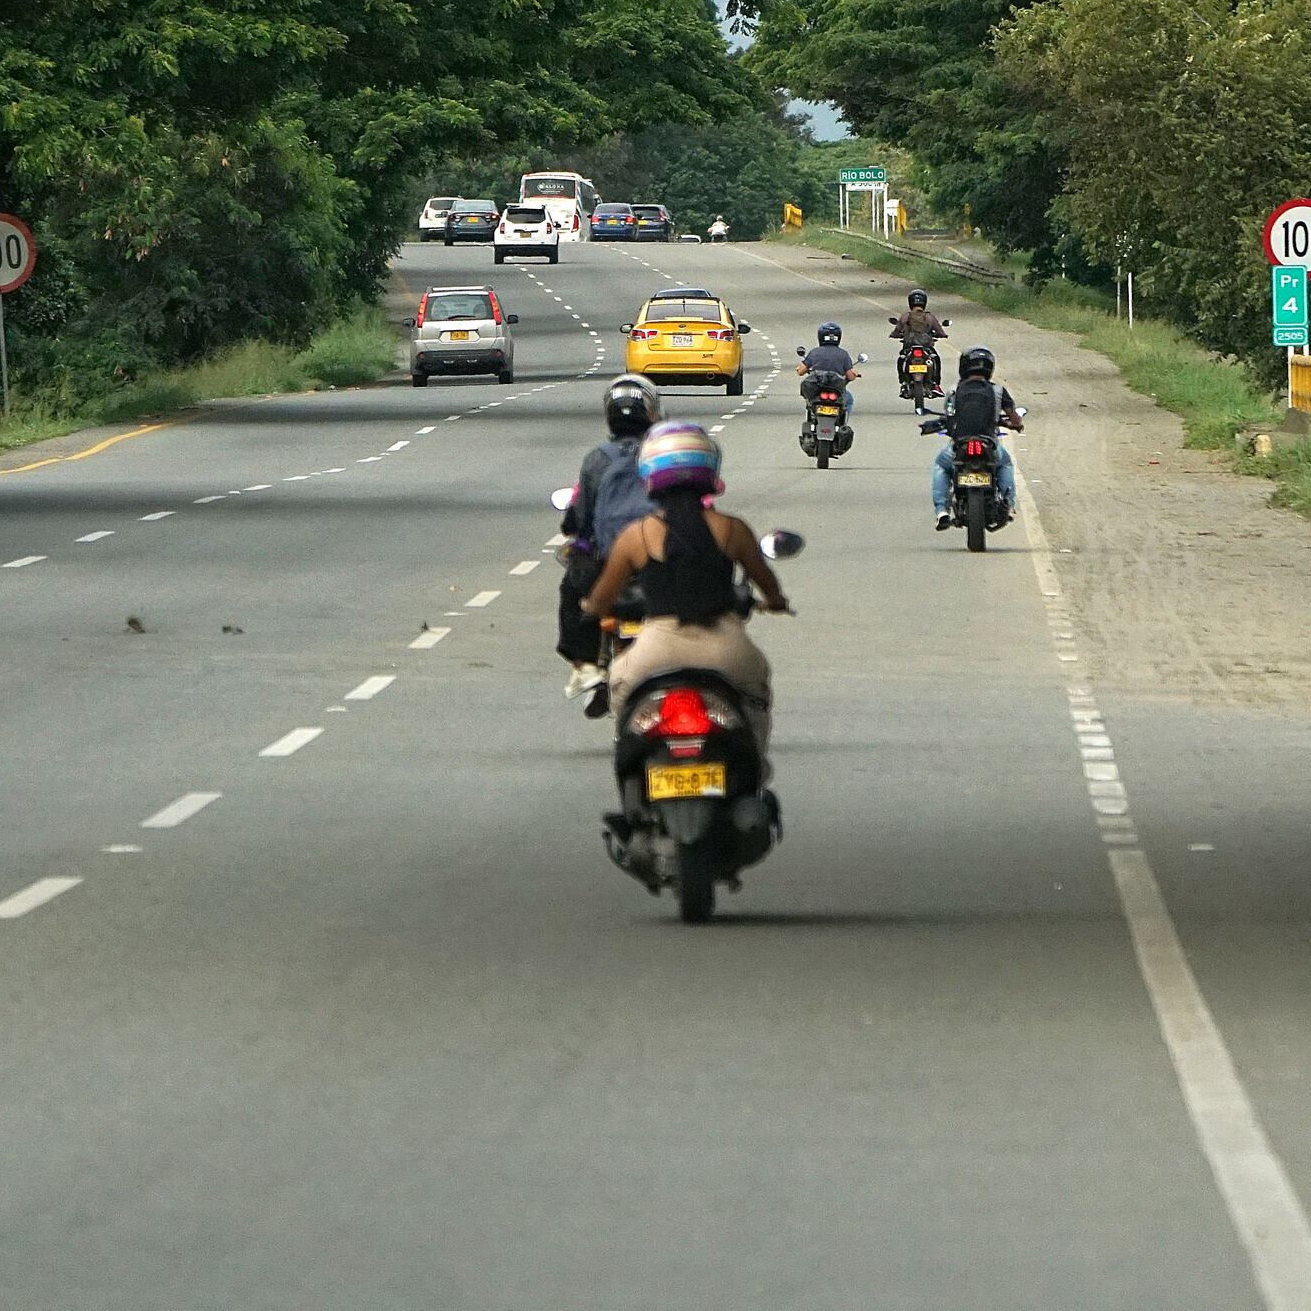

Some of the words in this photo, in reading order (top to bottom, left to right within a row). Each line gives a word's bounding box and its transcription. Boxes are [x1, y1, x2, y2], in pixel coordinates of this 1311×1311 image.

[859, 171, 884, 179] BOLO
[1280, 275, 1299, 288] Pr
[1282, 297, 1299, 314] 4
[1277, 332, 1304, 341] 2505
